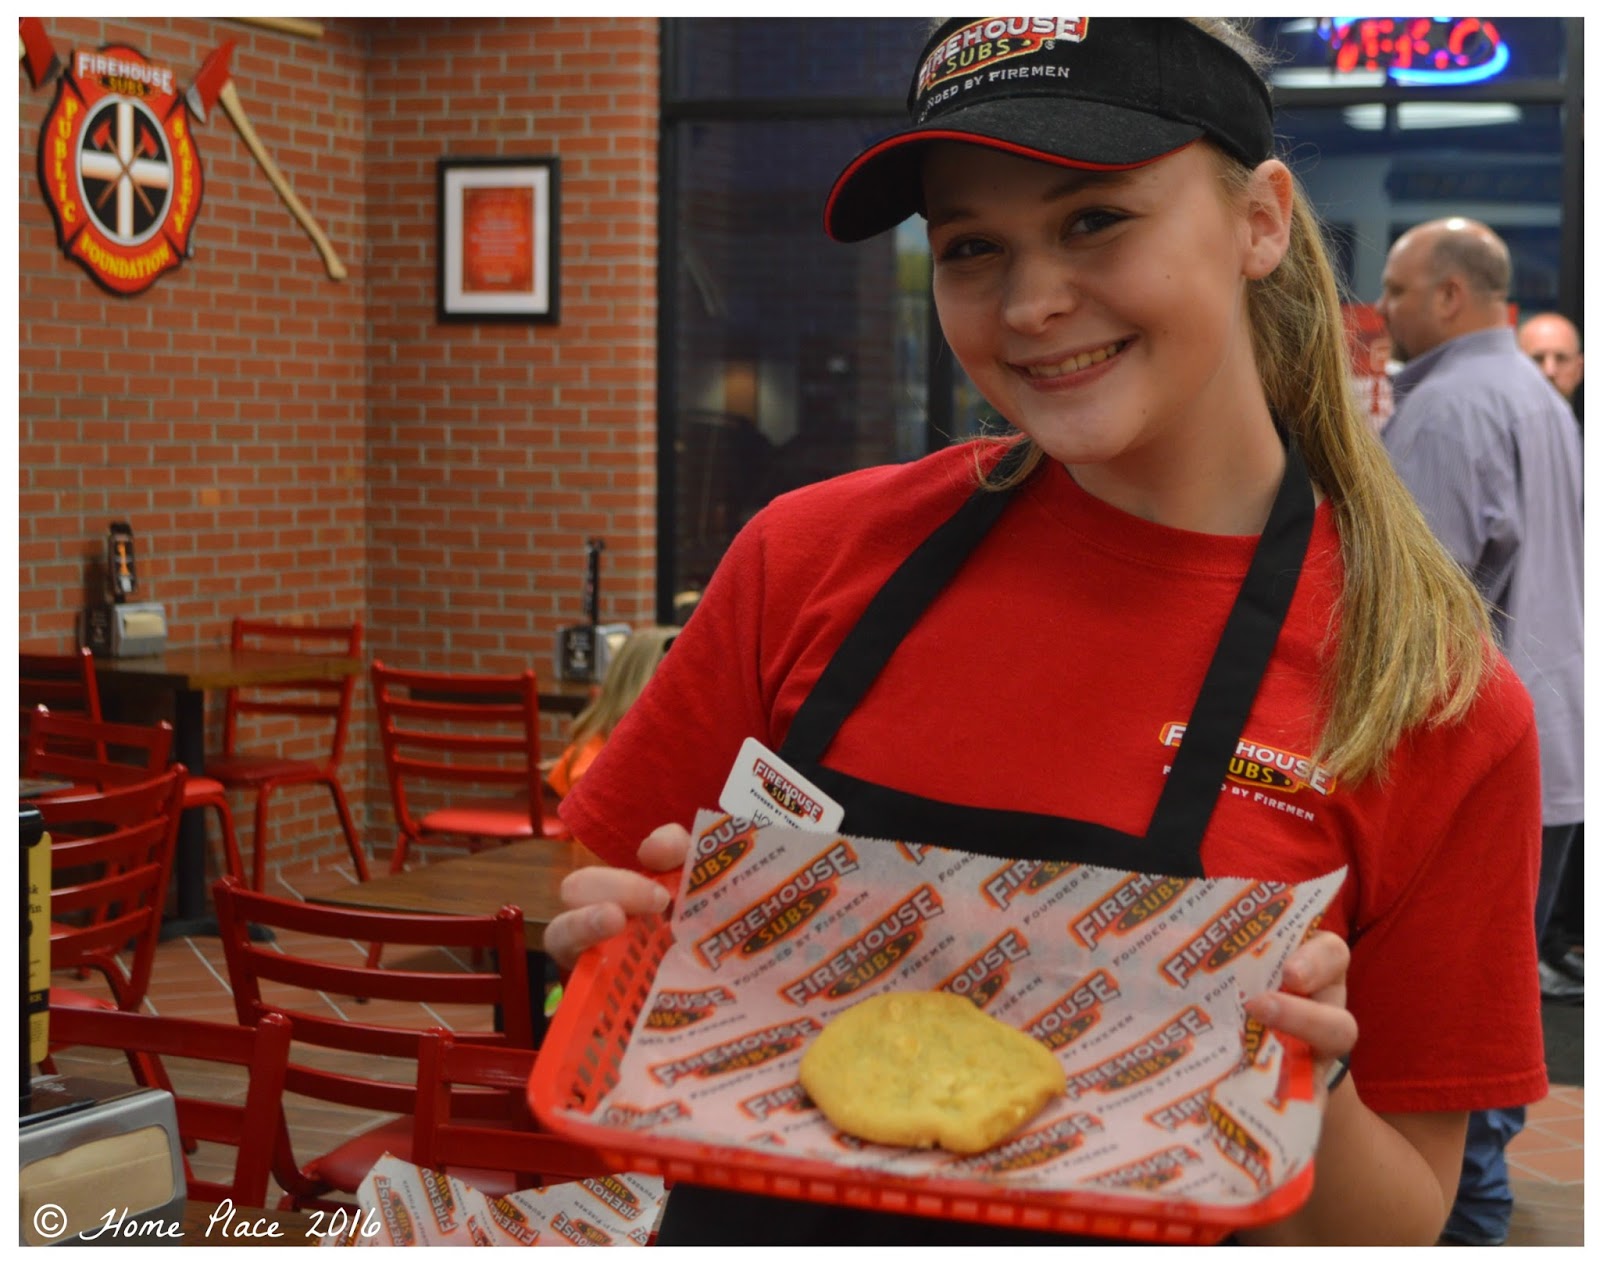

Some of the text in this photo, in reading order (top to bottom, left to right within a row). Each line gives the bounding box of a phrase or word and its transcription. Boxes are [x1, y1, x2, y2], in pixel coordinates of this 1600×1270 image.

[77, 53, 173, 96] FIREHOUSE
[945, 38, 1010, 74] SUBS
[964, 75, 984, 91] BY
[988, 66, 1071, 82] FIREMEN
[107, 77, 147, 98] SUBS
[54, 96, 78, 223] PUBLIC
[172, 116, 194, 234] SAFETY
[81, 231, 170, 280] FOUNDATION
[753, 761, 823, 824] FIREHOUSE
[1229, 757, 1275, 784] UBS
[1231, 786, 1249, 798] BY
[1253, 791, 1316, 823] FIREMEN
[732, 845, 786, 887] FIREMEN
[937, 852, 980, 883] FOUND
[700, 844, 860, 972] FIREHOUSE
[758, 898, 815, 943] SUBS
[815, 890, 870, 933] FIREMEN
[1023, 879, 1079, 926] FOUNDED
[1075, 874, 1163, 952] FIREH
[1130, 877, 1185, 921] SUBS
[1275, 888, 1322, 938] FIREMEN
[785, 888, 945, 1007] FIREHOUSE
[1112, 921, 1168, 967] FOUNDED
[1169, 907, 1185, 923] BY
[1164, 881, 1288, 990] FIREHOUS
[1221, 911, 1274, 954] SUBS
[843, 942, 901, 989] SUBS
[901, 934, 956, 979] FIREMEN
[1066, 1008, 1215, 1100] FIREHOUSE
[421, 1167, 460, 1232] FIREHOU
